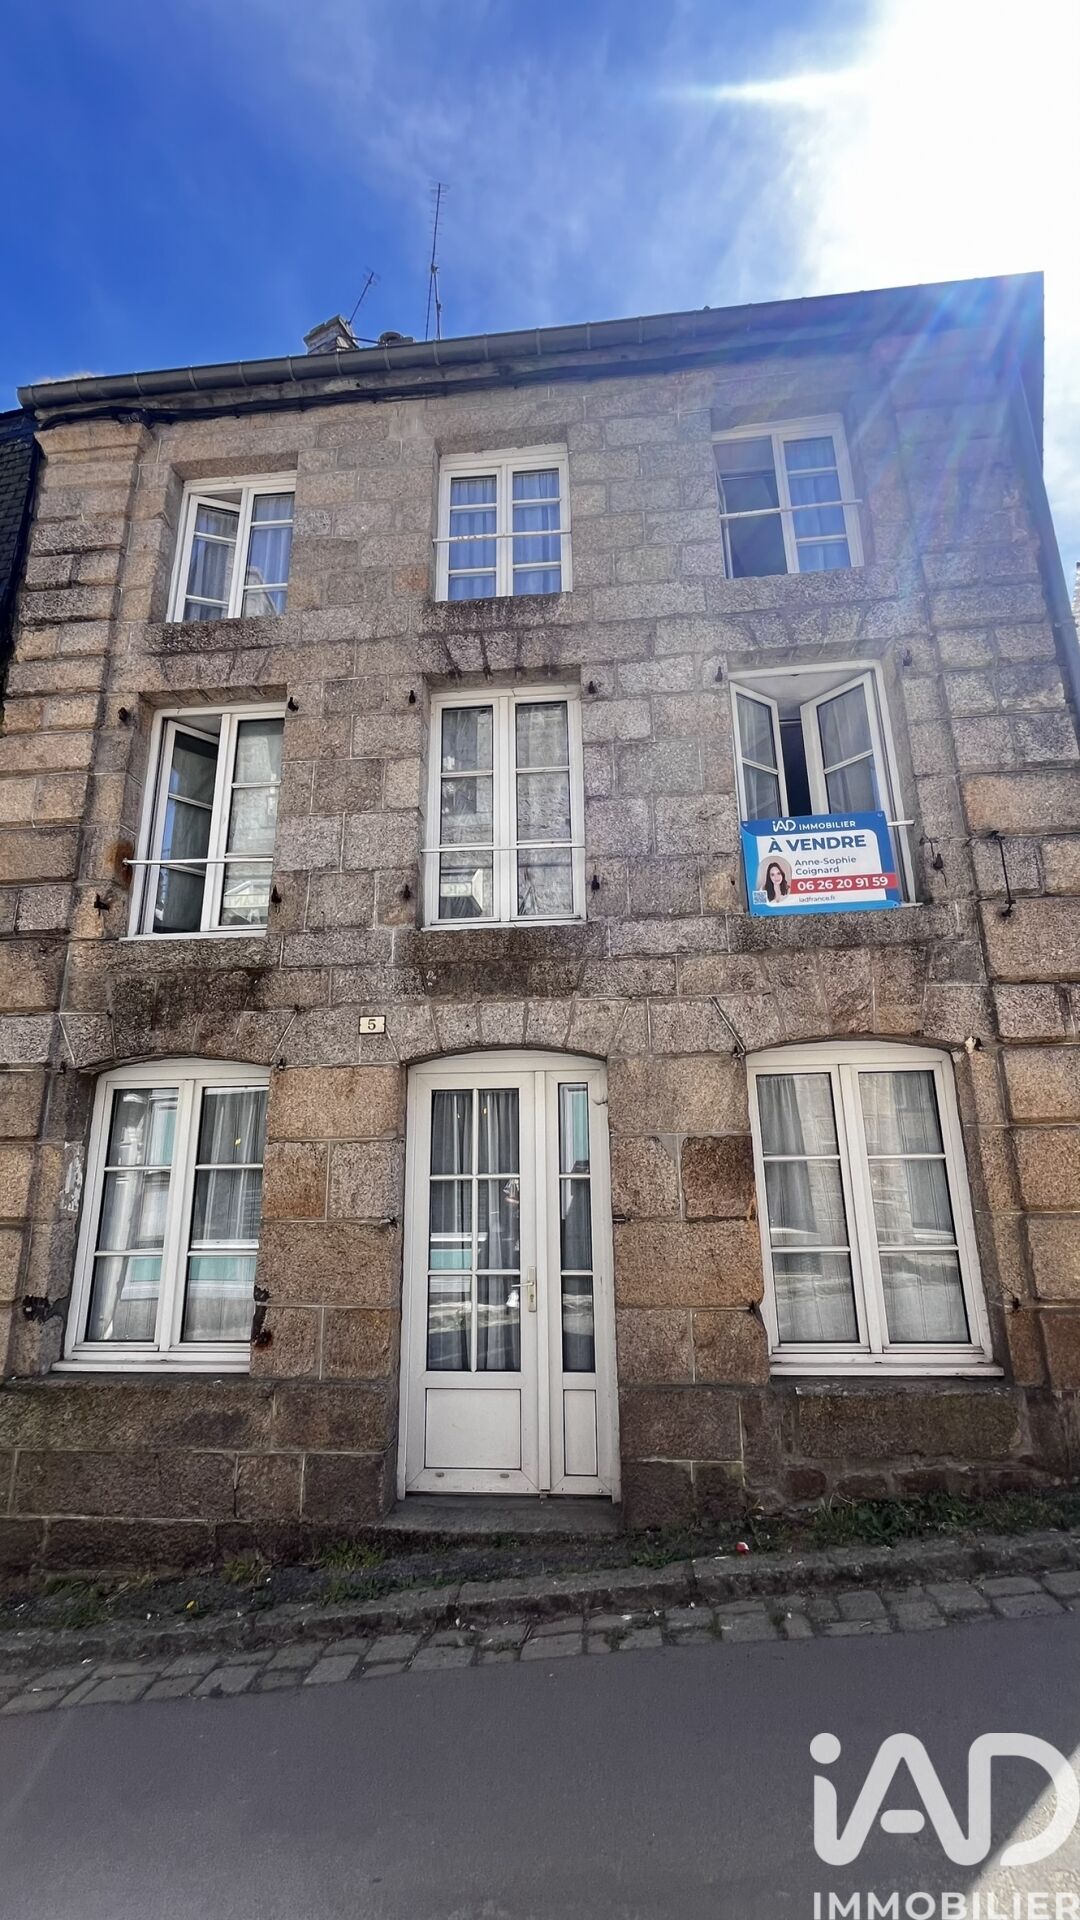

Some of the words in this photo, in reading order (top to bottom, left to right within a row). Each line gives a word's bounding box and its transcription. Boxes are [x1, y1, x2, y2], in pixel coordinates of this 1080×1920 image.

[799, 820, 856, 831] IMMOBILIER
[768, 837, 783, 853] À
[786, 834, 867, 852] VENDRE
[794, 856, 857, 867] Anne-Sophie
[795, 866, 840, 876] Coignard
[797, 880, 815, 891] 06
[818, 879, 834, 890] 26
[836, 878, 853, 889] 20
[856, 877, 869, 888] 91
[872, 876, 888, 887] 59
[798, 895, 836, 903] iadfrance.fr
[367, 1018, 376, 1031] 5
